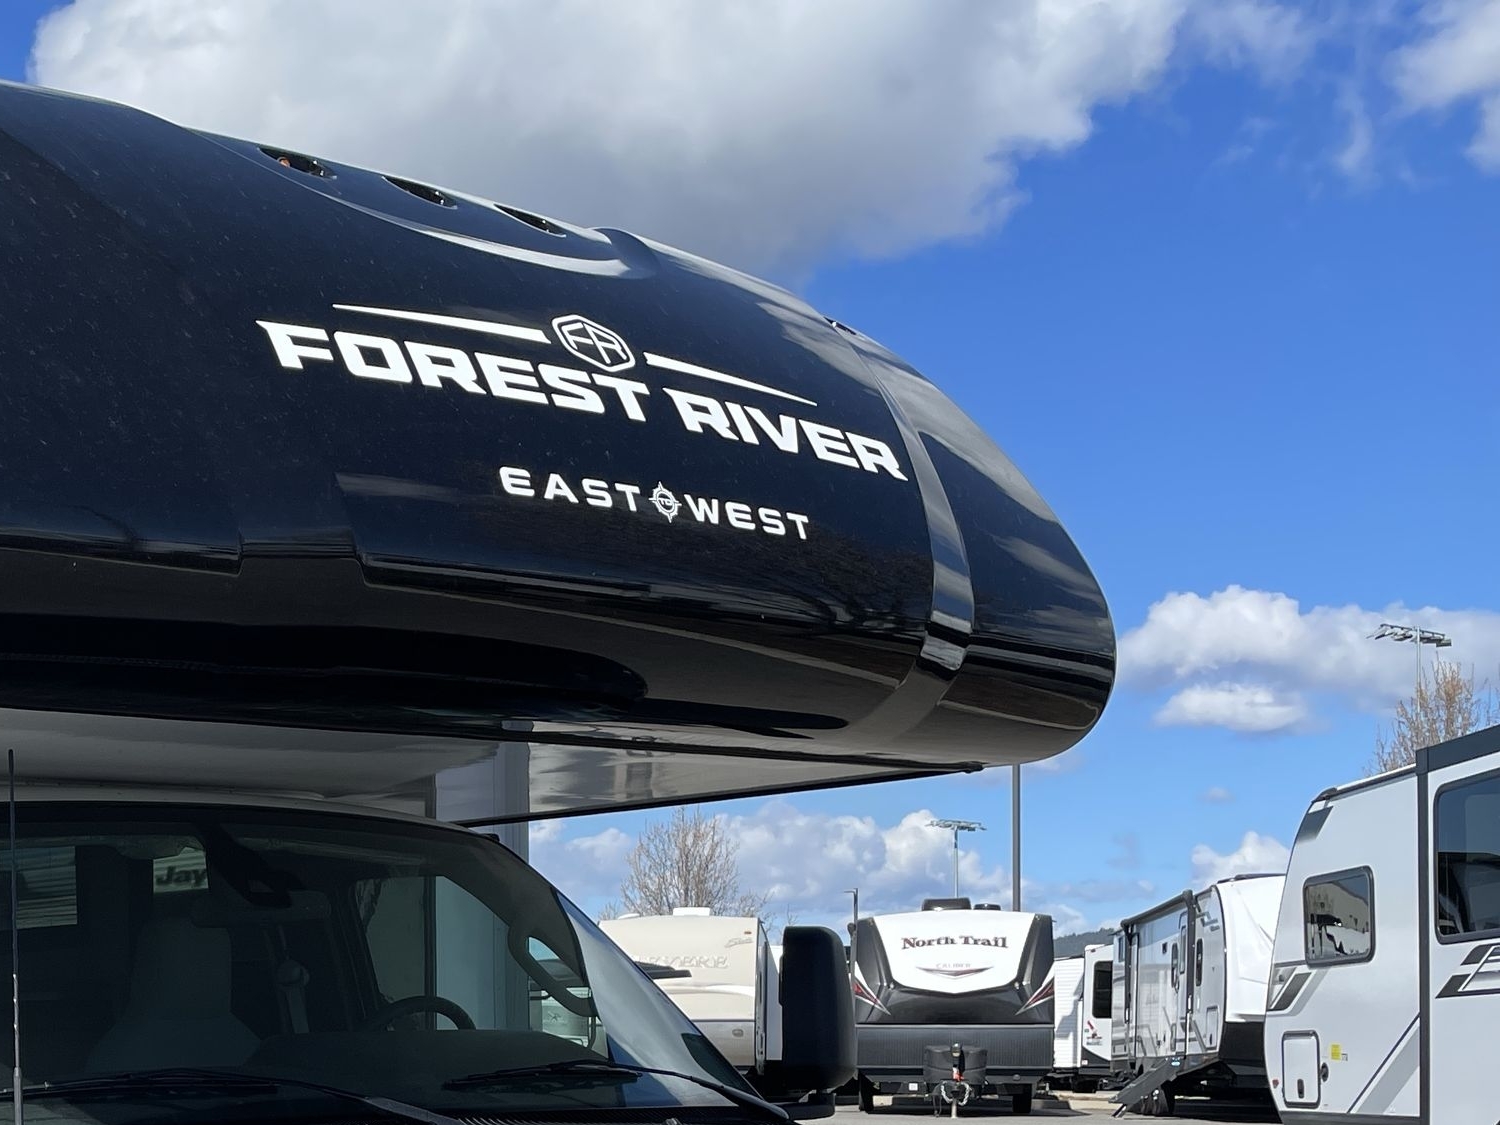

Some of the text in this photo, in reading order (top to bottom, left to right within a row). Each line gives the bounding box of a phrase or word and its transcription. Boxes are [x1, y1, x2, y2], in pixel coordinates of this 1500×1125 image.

[255, 319, 908, 481] FOREST RIVER
[499, 466, 641, 512] EAST
[683, 493, 809, 540] WEST
[901, 935, 1009, 950] North Trail
